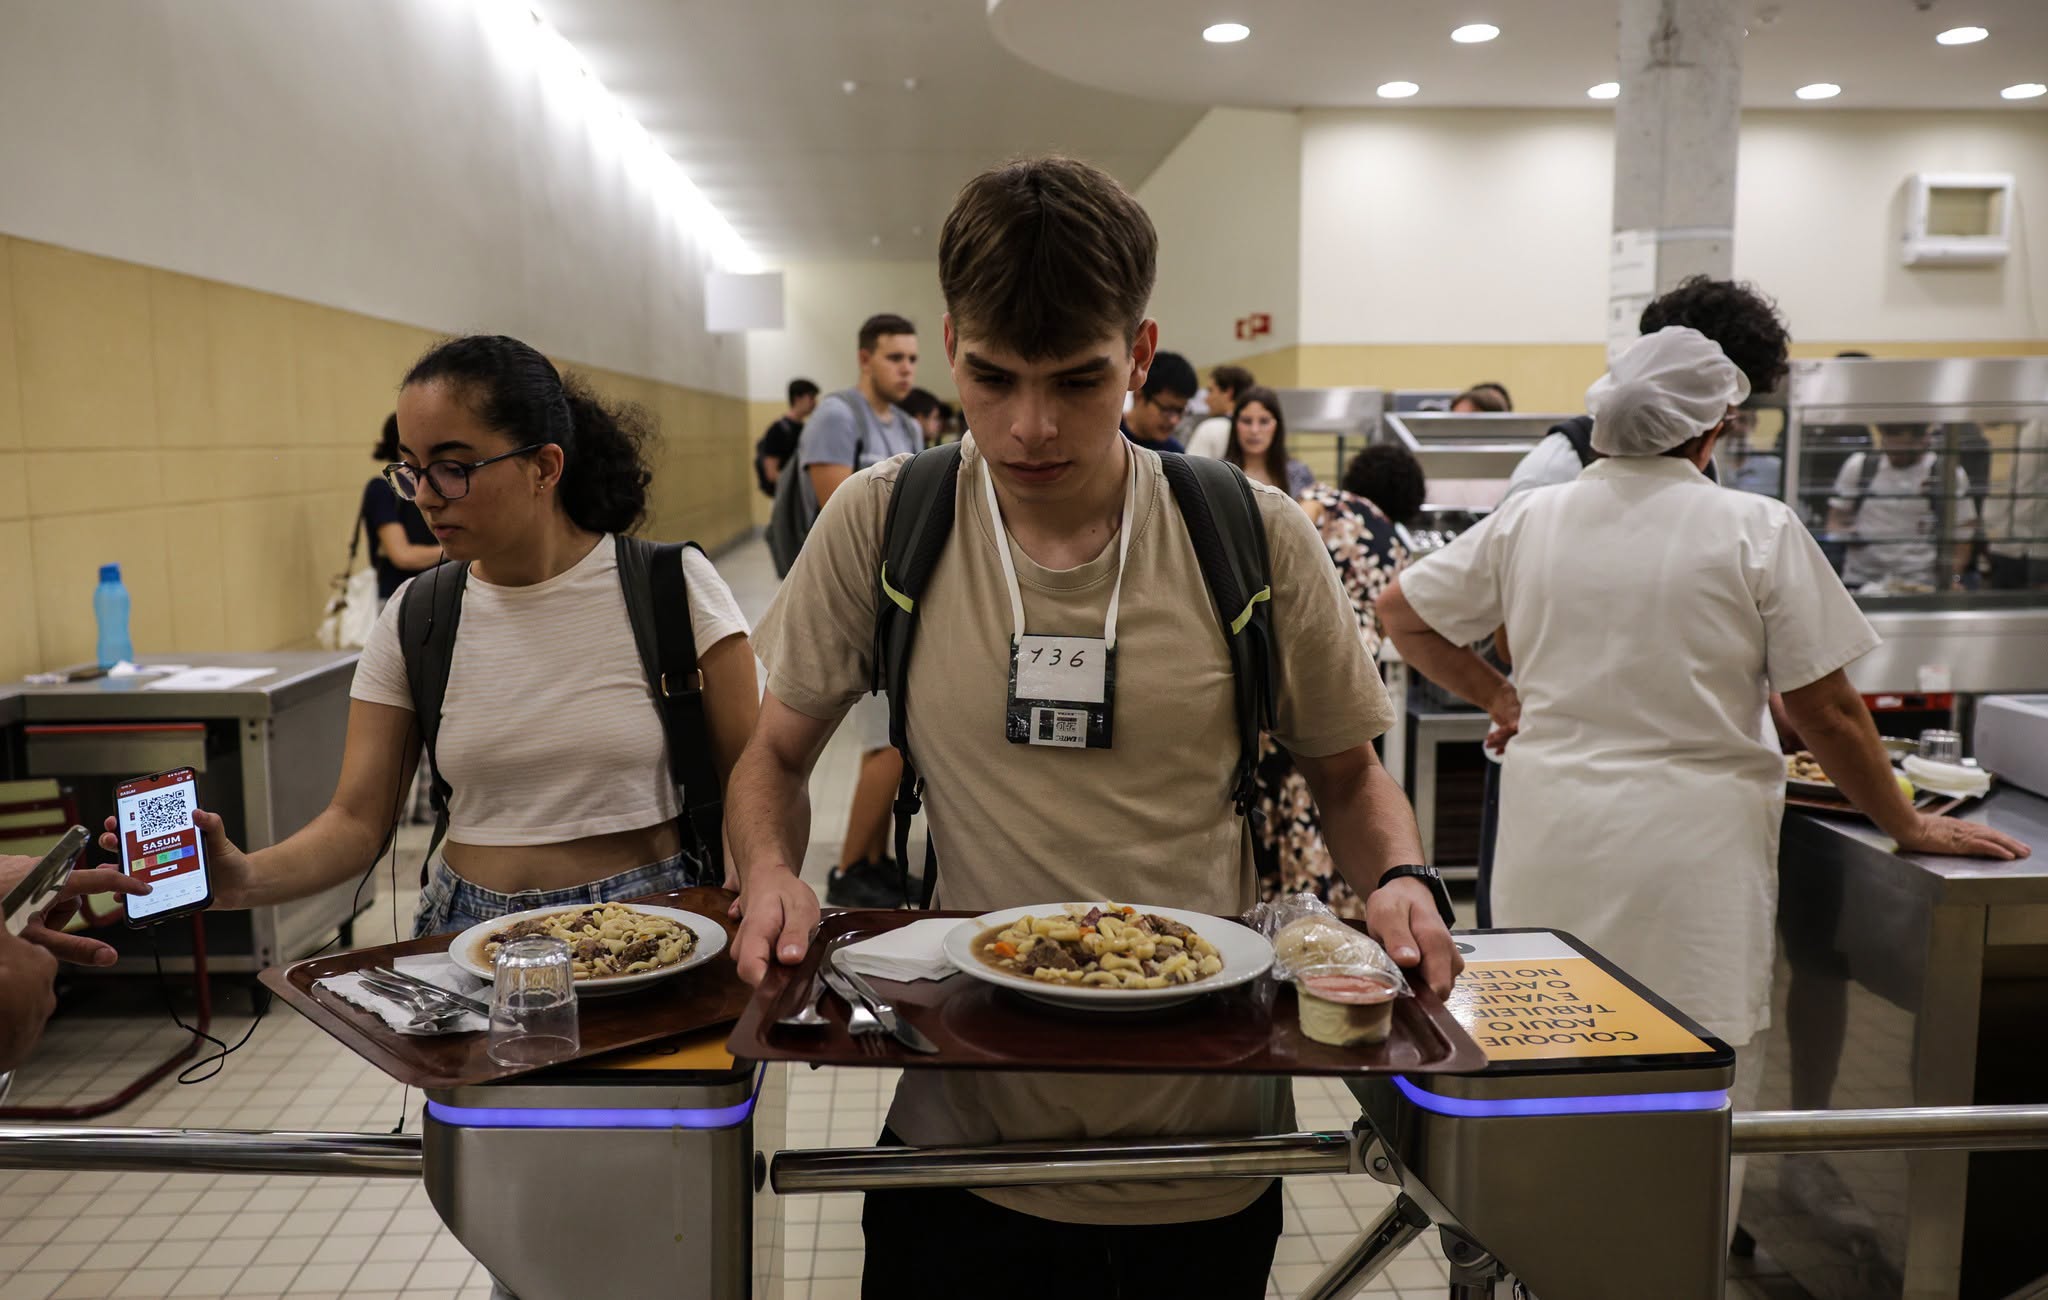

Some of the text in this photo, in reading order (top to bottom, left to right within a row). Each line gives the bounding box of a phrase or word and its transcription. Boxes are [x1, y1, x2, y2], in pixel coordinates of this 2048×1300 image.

[142, 836, 180, 851] SASUM
[1456, 968, 1563, 980] NO LEIT
[1455, 980, 1571, 992] O ACESS
[1473, 992, 1580, 1005] E VALID
[1473, 1004, 1617, 1018] TABULEIR
[1488, 1018, 1597, 1032] AQUI O
[1480, 1032, 1639, 1047] COLOQUE
